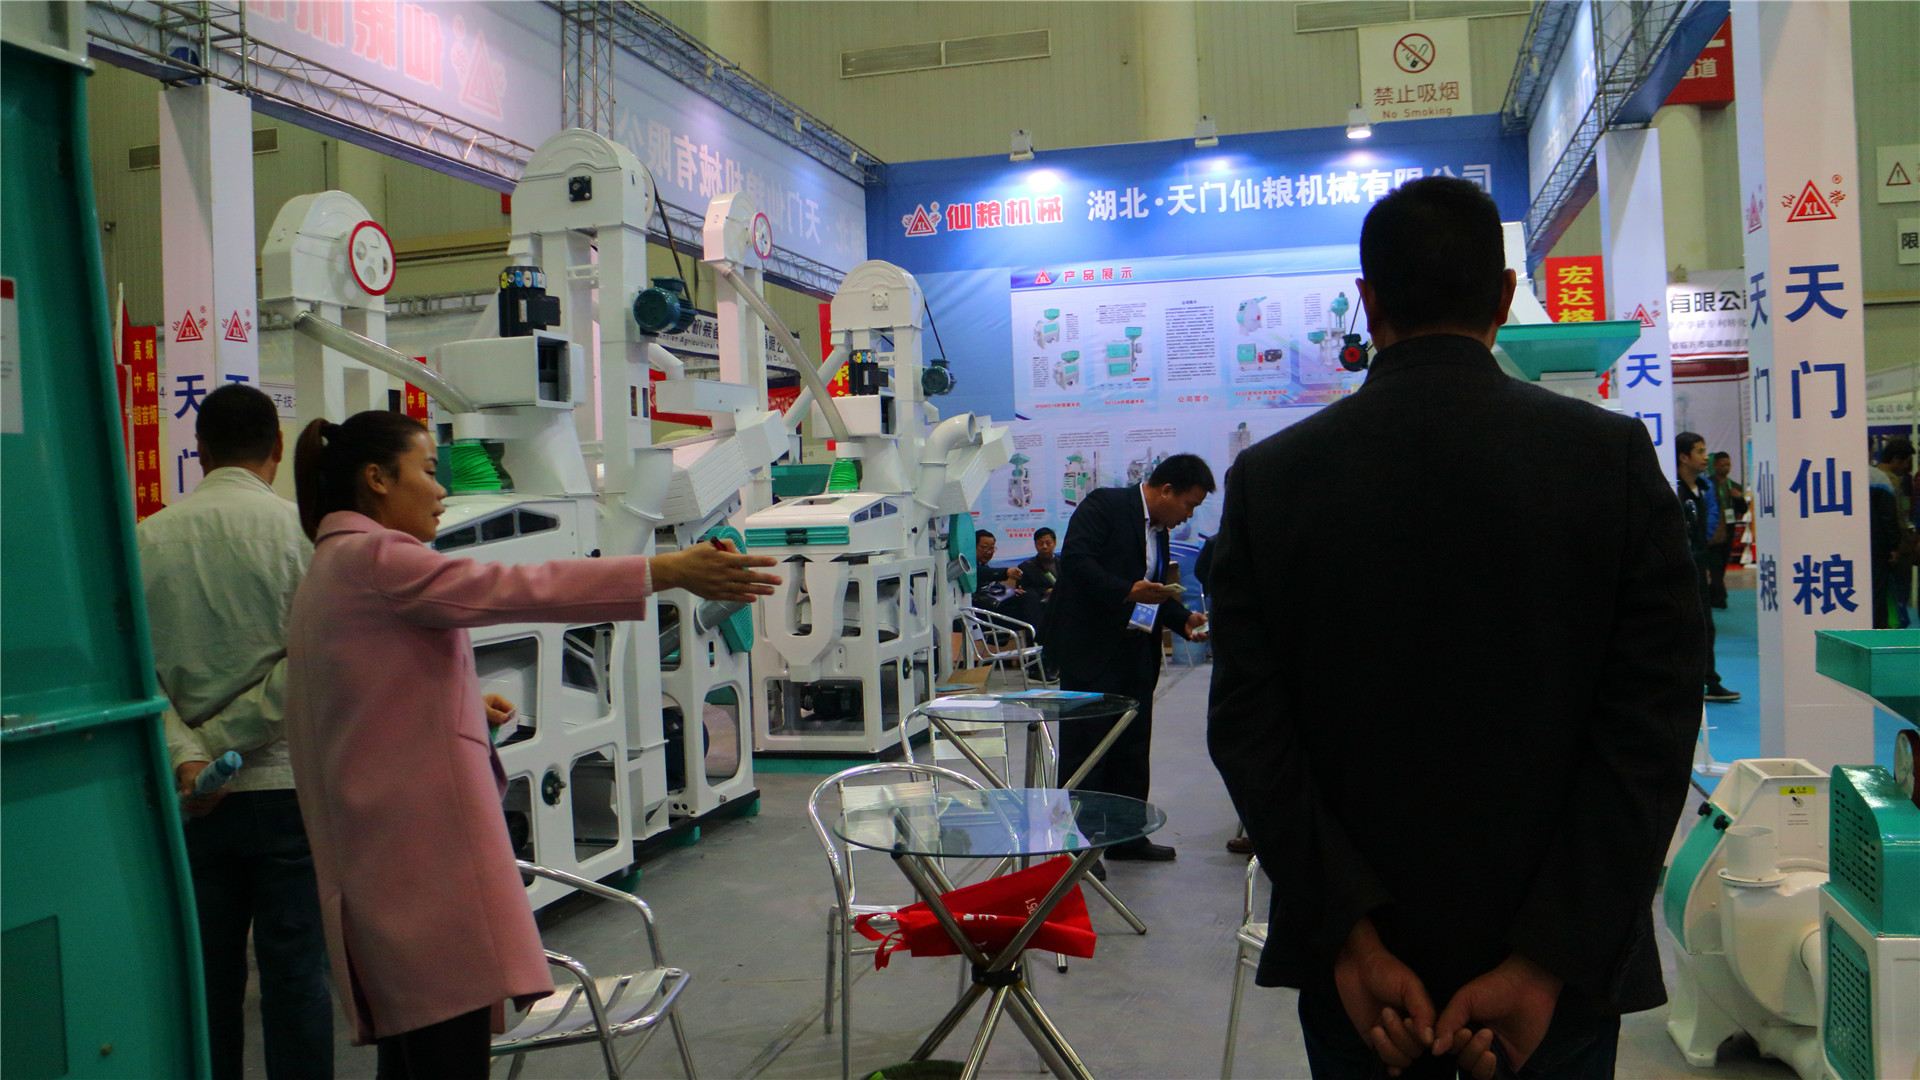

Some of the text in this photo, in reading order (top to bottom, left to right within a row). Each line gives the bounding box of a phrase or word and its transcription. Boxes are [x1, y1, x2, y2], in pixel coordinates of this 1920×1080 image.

[1373, 81, 1459, 106] 禁止吸烟
[1382, 107, 1453, 119] No Smoking
[945, 195, 1064, 232] 仙粮机械
[1804, 201, 1822, 216] XL
[1064, 266, 1133, 283] 产品展示
[1670, 289, 1747, 314] 有限公
[1784, 263, 1859, 615] 天门仙粮
